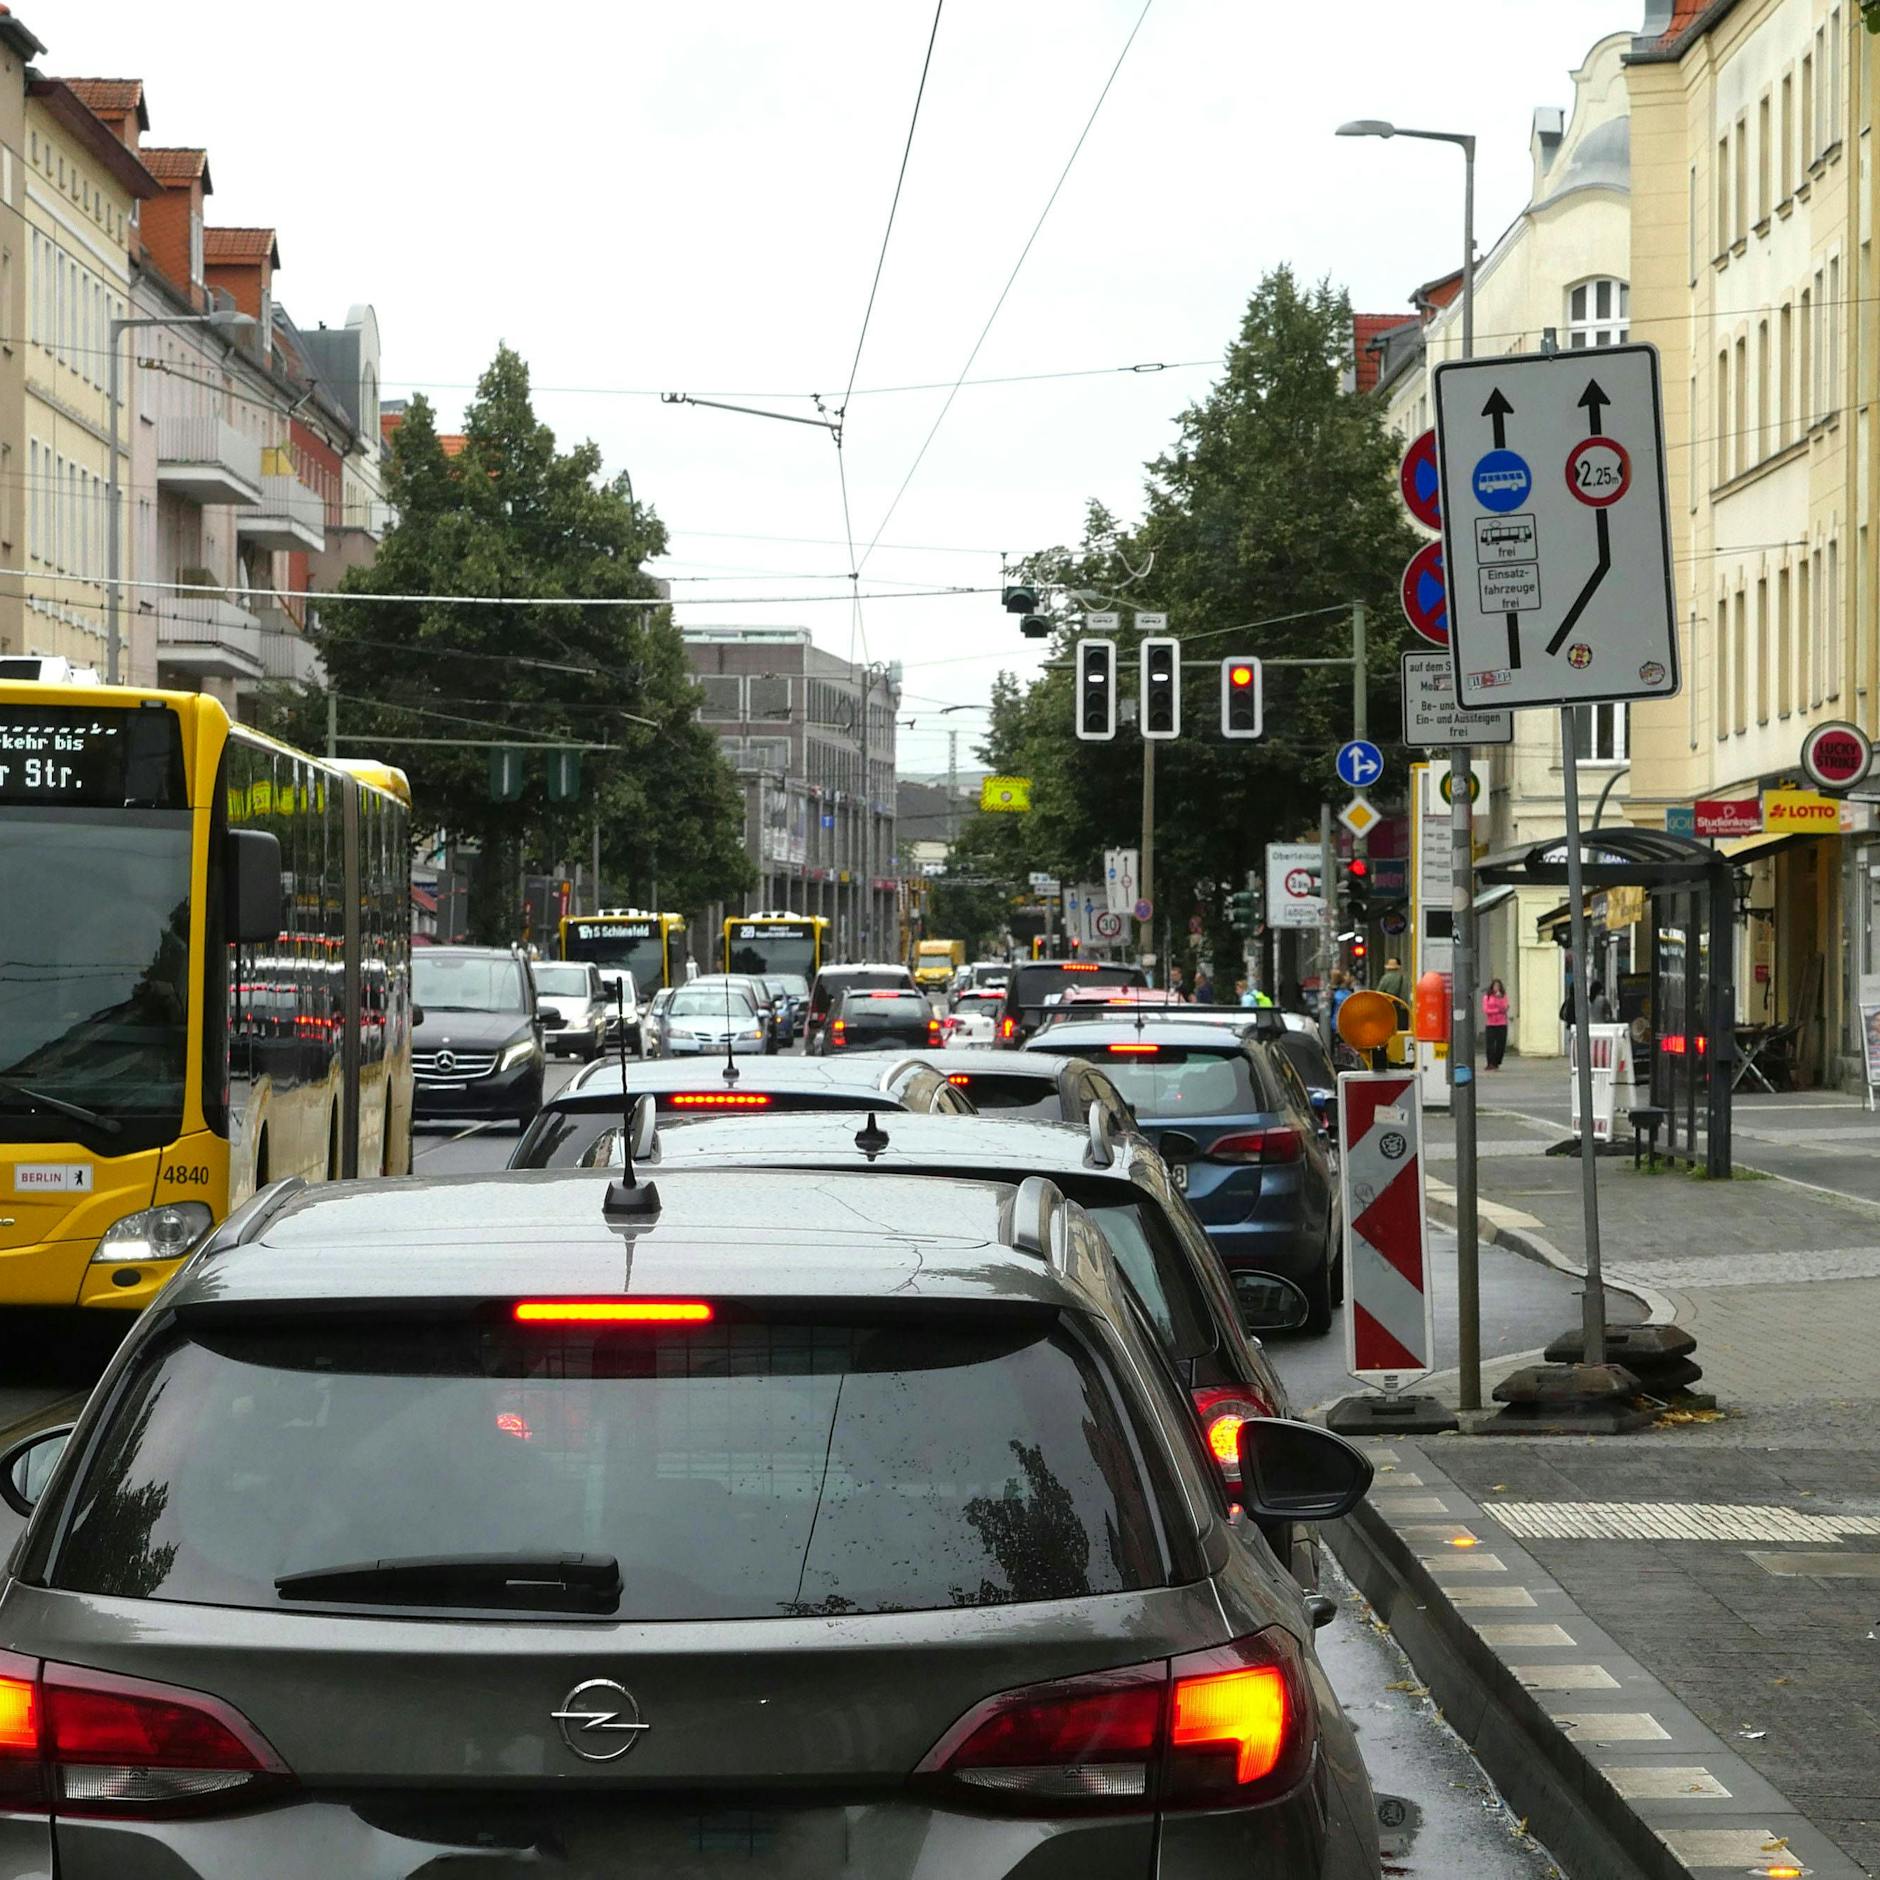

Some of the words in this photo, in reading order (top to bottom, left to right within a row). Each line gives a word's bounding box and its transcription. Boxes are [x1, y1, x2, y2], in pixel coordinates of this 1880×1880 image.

[1498, 546, 1516, 557] frei
[1487, 568, 1530, 580] Einsatz-
[1484, 584, 1535, 595] fahrzeuge
[1502, 597, 1520, 608] frei
[1409, 661, 1423, 672] auf
[1425, 661, 1444, 672] dem
[1421, 701, 1437, 711] Be-
[1416, 714, 1434, 725] Ein-
[1437, 714, 1453, 724] und
[1454, 713, 1501, 725] Aussteigen
[1449, 726, 1468, 737] frei
[0, 734, 48, 749] kehr
[55, 735, 84, 751] bis
[1819, 742, 1857, 756] LUCKY
[1817, 756, 1858, 769] STRIKE
[25, 759, 82, 788] Str.
[1789, 806, 1836, 818] LOTTO
[1101, 918, 1117, 931] 30
[21, 1173, 62, 1183] BERLIN
[163, 1165, 210, 1185] 4840
